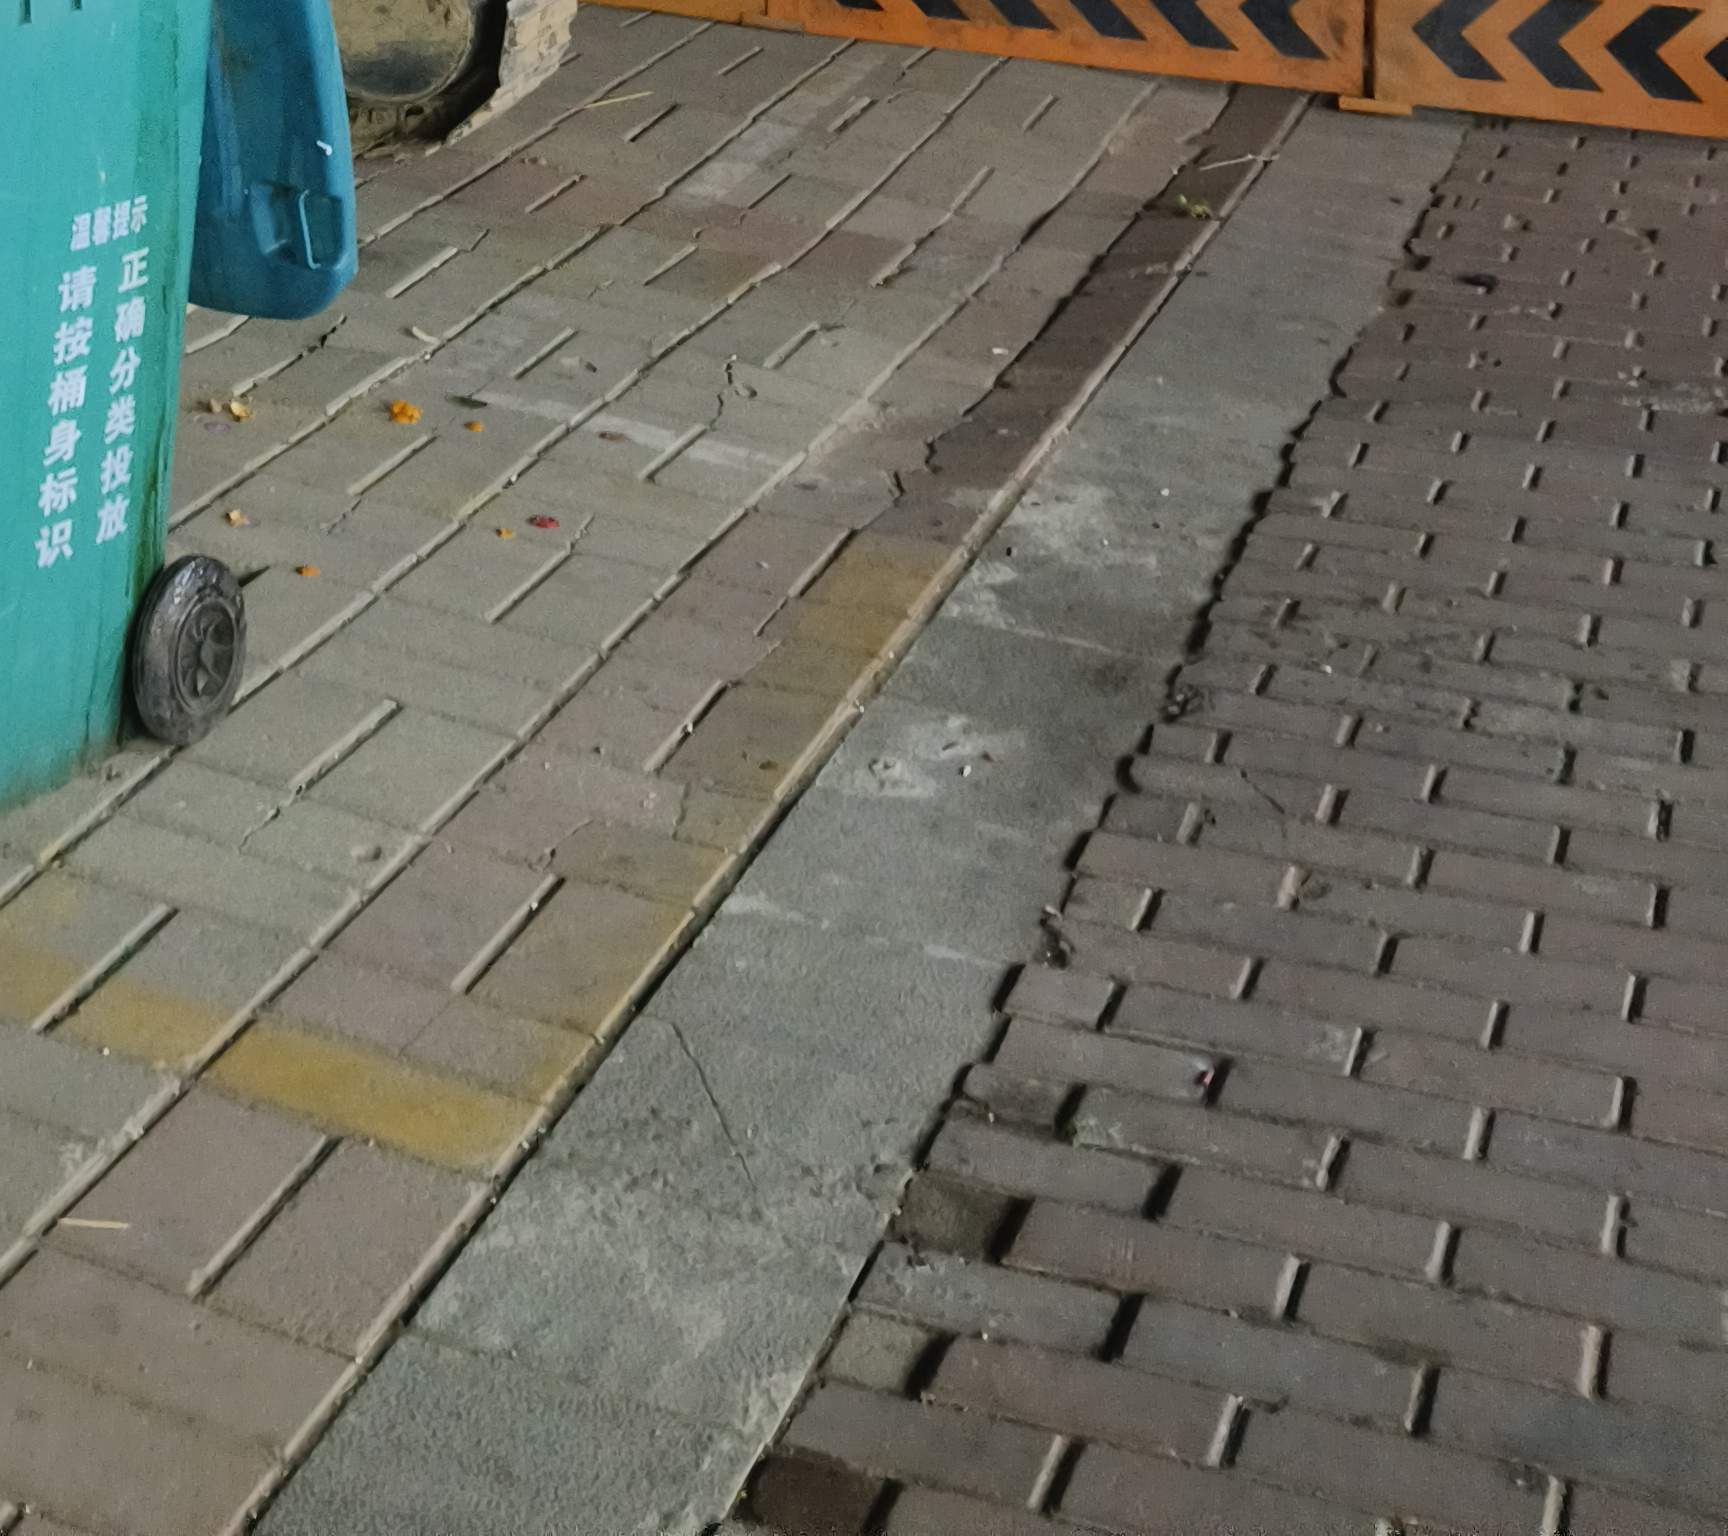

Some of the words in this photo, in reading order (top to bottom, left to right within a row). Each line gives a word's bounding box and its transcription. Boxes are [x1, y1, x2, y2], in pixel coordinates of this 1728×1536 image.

[70, 194, 149, 252] 温馨提示
[34, 265, 98, 568] 请按桶身标识
[96, 247, 150, 544] 正确分类投放
